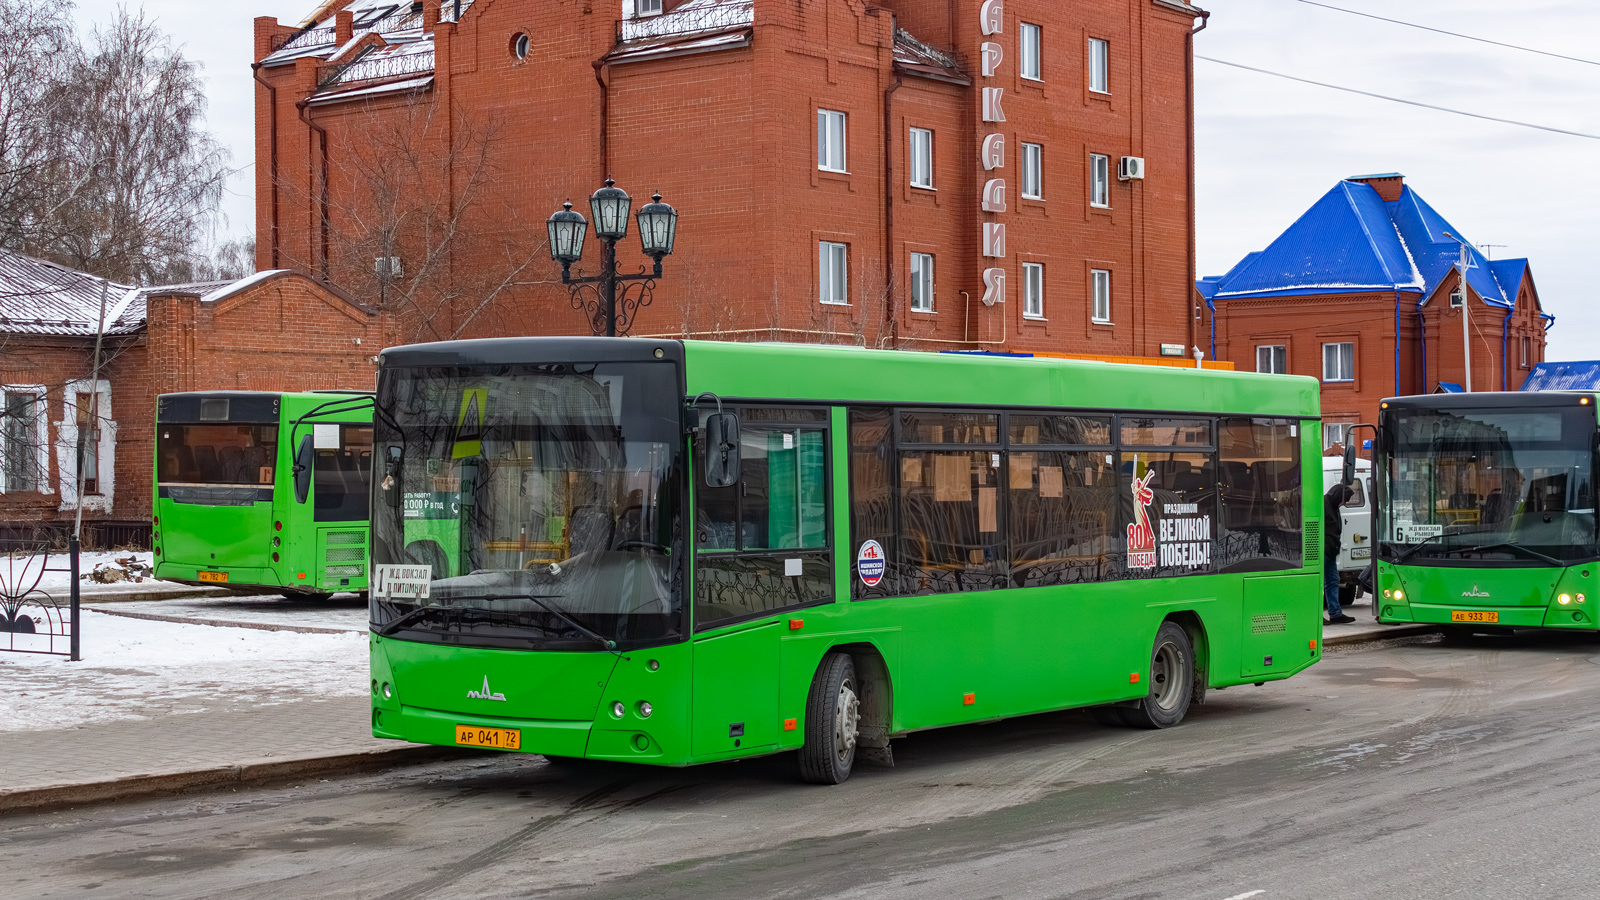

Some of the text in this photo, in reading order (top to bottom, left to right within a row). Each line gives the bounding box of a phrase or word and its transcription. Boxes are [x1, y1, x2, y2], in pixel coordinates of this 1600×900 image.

[980, 0, 1006, 306] АРКАДИЯ
[435, 502, 443, 510] год
[1164, 504, 1198, 515] ПРАЗДНИКОМ
[1160, 514, 1211, 542] ВЕЛИКОЙ
[1396, 526, 1404, 542] 6
[1128, 524, 1143, 550] 80
[1128, 554, 1156, 568] ПОБЕДА!
[1160, 542, 1211, 569] ПОБЕДЫ!
[210, 573, 219, 581] 782
[378, 567, 384, 593] 1
[402, 568, 428, 580] ВОКЗАЛ
[393, 583, 428, 594] ПИТОМНИК
[1455, 612, 1496, 621] АЕ 933 72
[461, 730, 516, 745] АР 041 72
